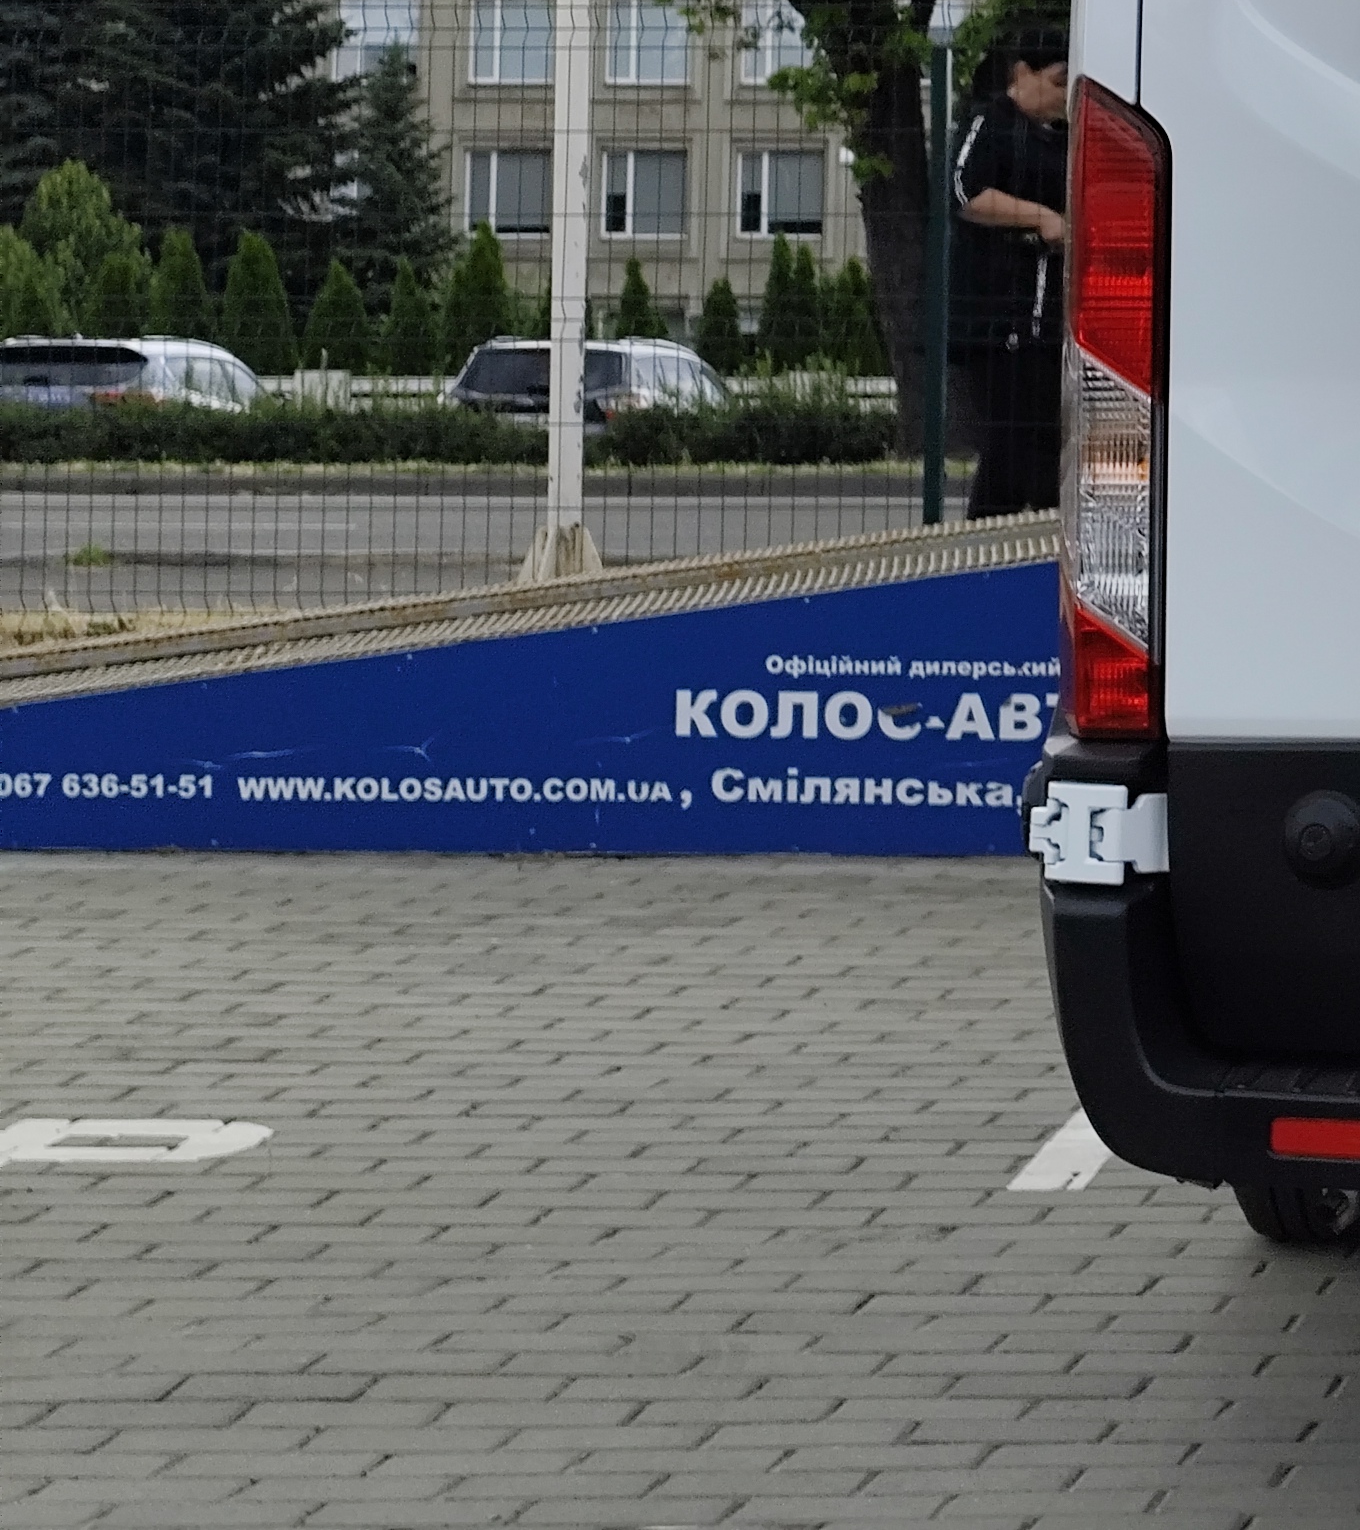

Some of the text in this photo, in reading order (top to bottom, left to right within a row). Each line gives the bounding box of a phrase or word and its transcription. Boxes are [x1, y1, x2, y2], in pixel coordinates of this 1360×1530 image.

[765, 654, 902, 679] Офіційний
[0, 772, 52, 799] 067
[61, 772, 213, 800] 636-51-51
